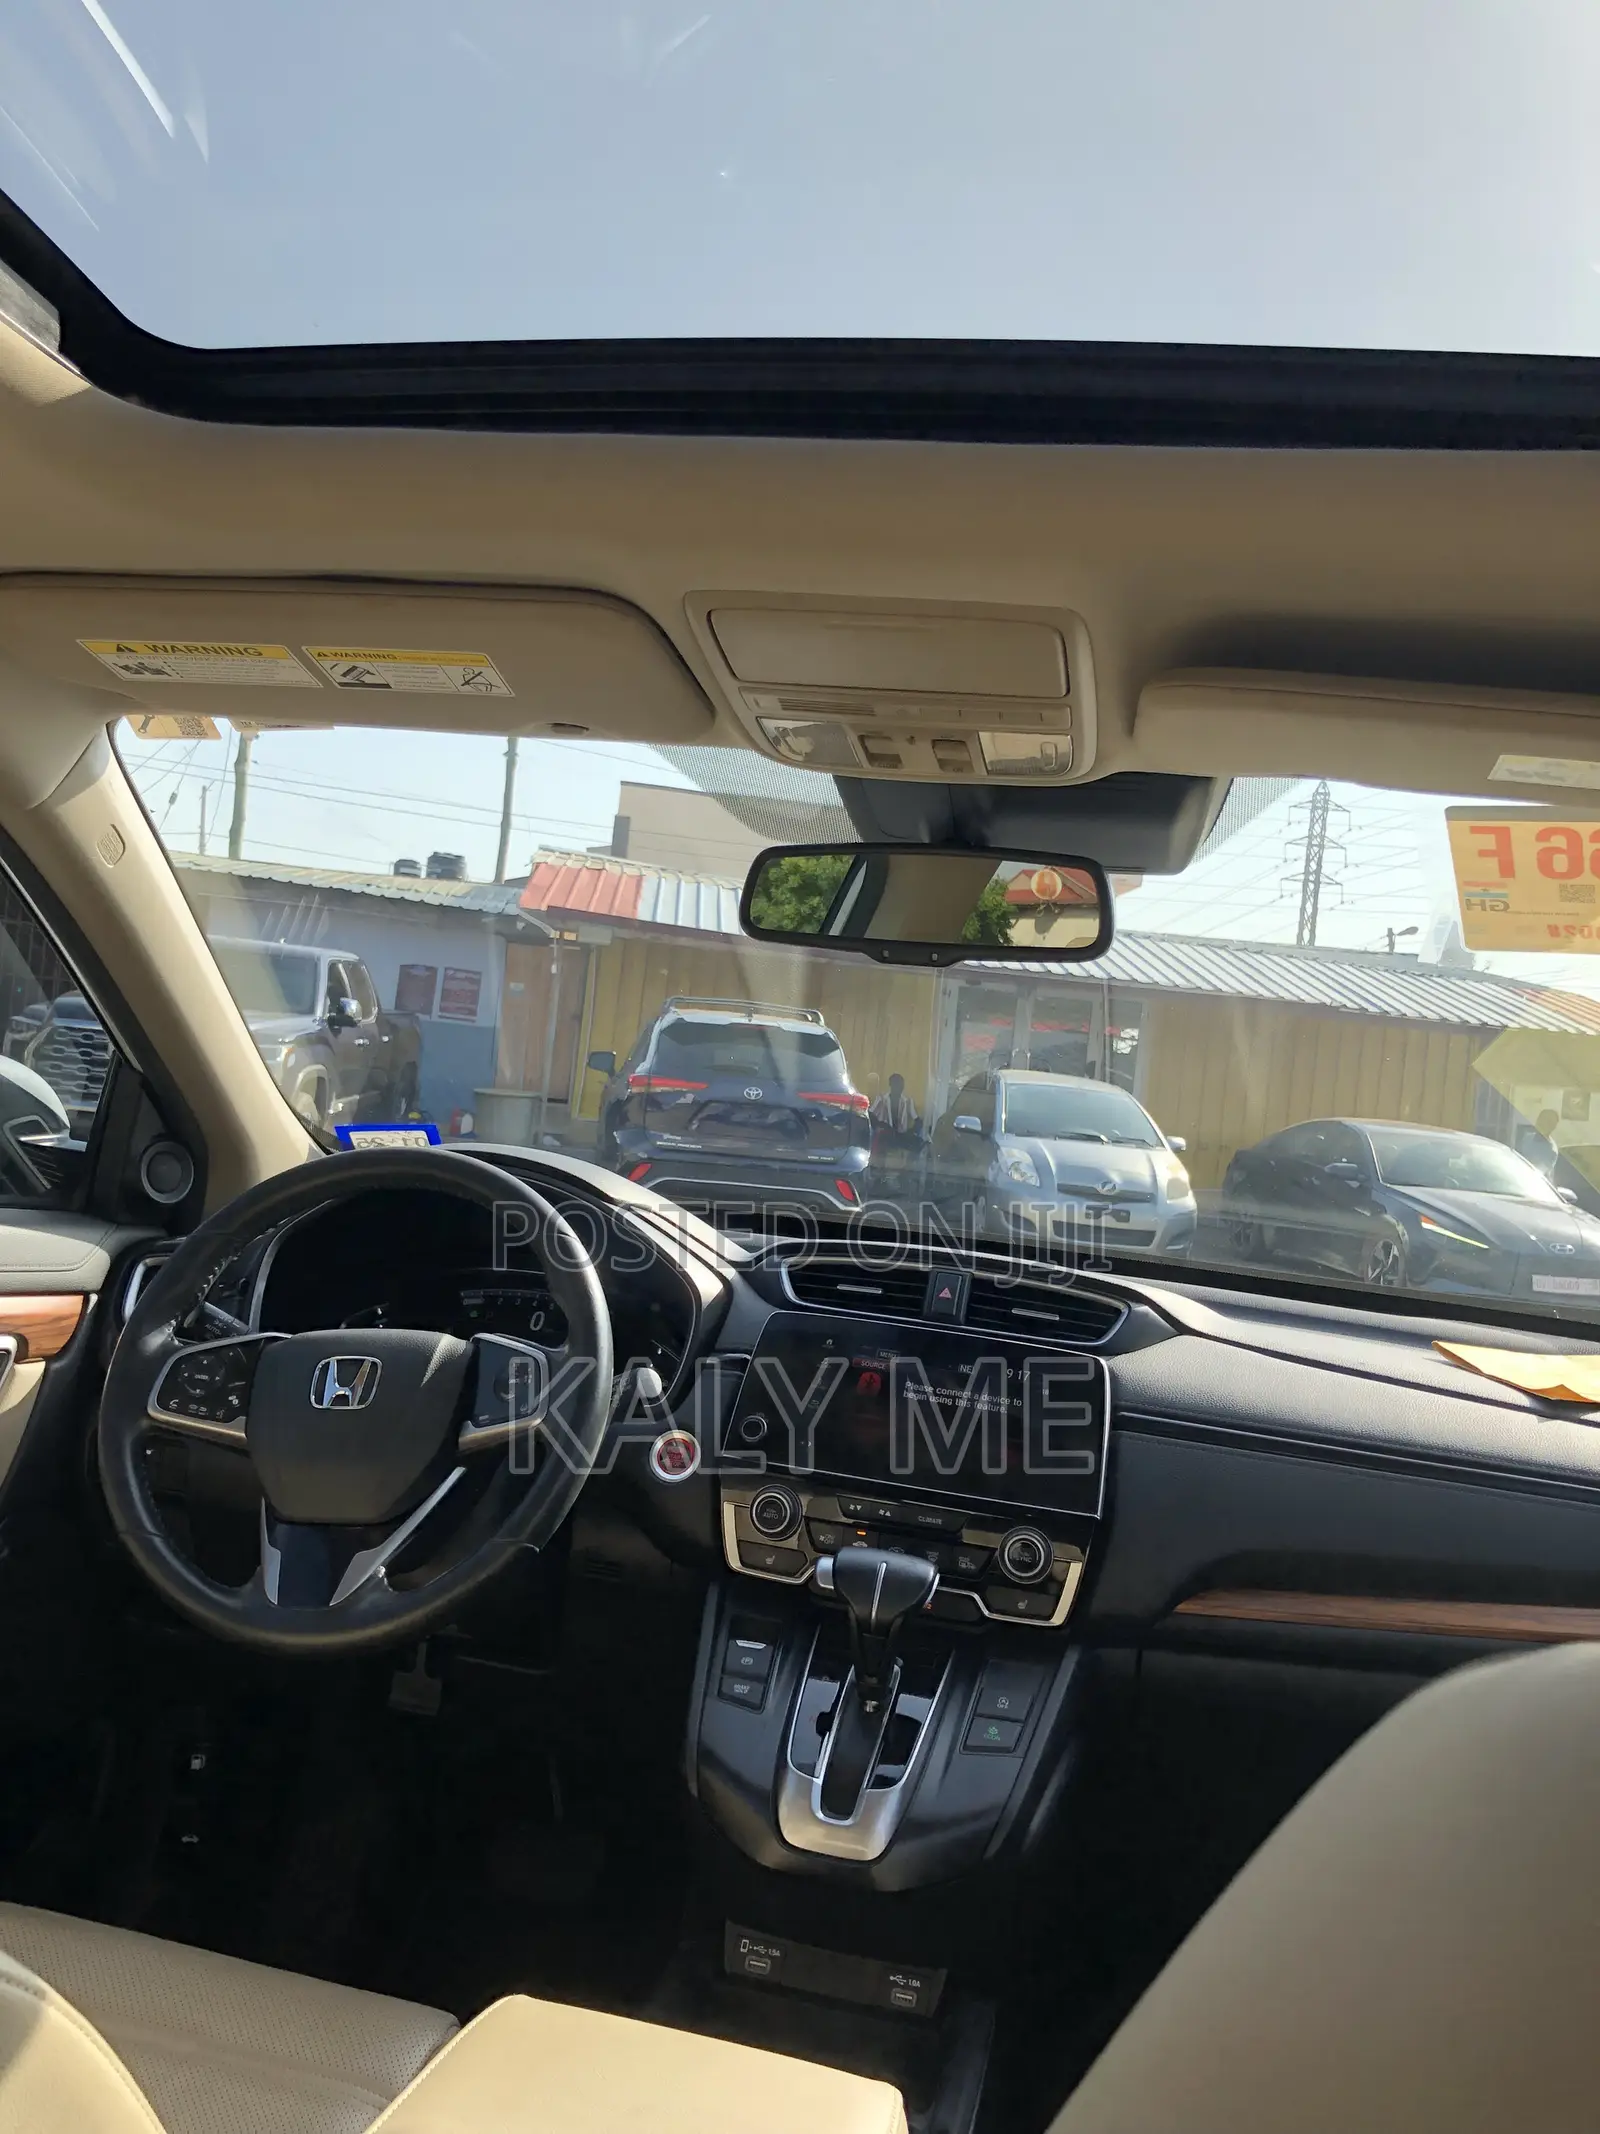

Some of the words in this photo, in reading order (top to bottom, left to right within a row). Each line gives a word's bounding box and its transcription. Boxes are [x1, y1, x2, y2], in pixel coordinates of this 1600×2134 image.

[144, 643, 264, 657] WARNING
[530, 1311, 546, 1331] 0
[860, 1359, 887, 1370] SOURCE
[903, 1390, 927, 1401] begin
[929, 1394, 953, 1406] using
[955, 1399, 971, 1408] this
[974, 1401, 1008, 1414] feature.
[905, 1380, 934, 1393] Please
[936, 1386, 972, 1399] connect
[981, 1393, 1011, 1405] device
[1013, 1398, 1022, 1407] to
[917, 1515, 943, 1525] CLIMATE
